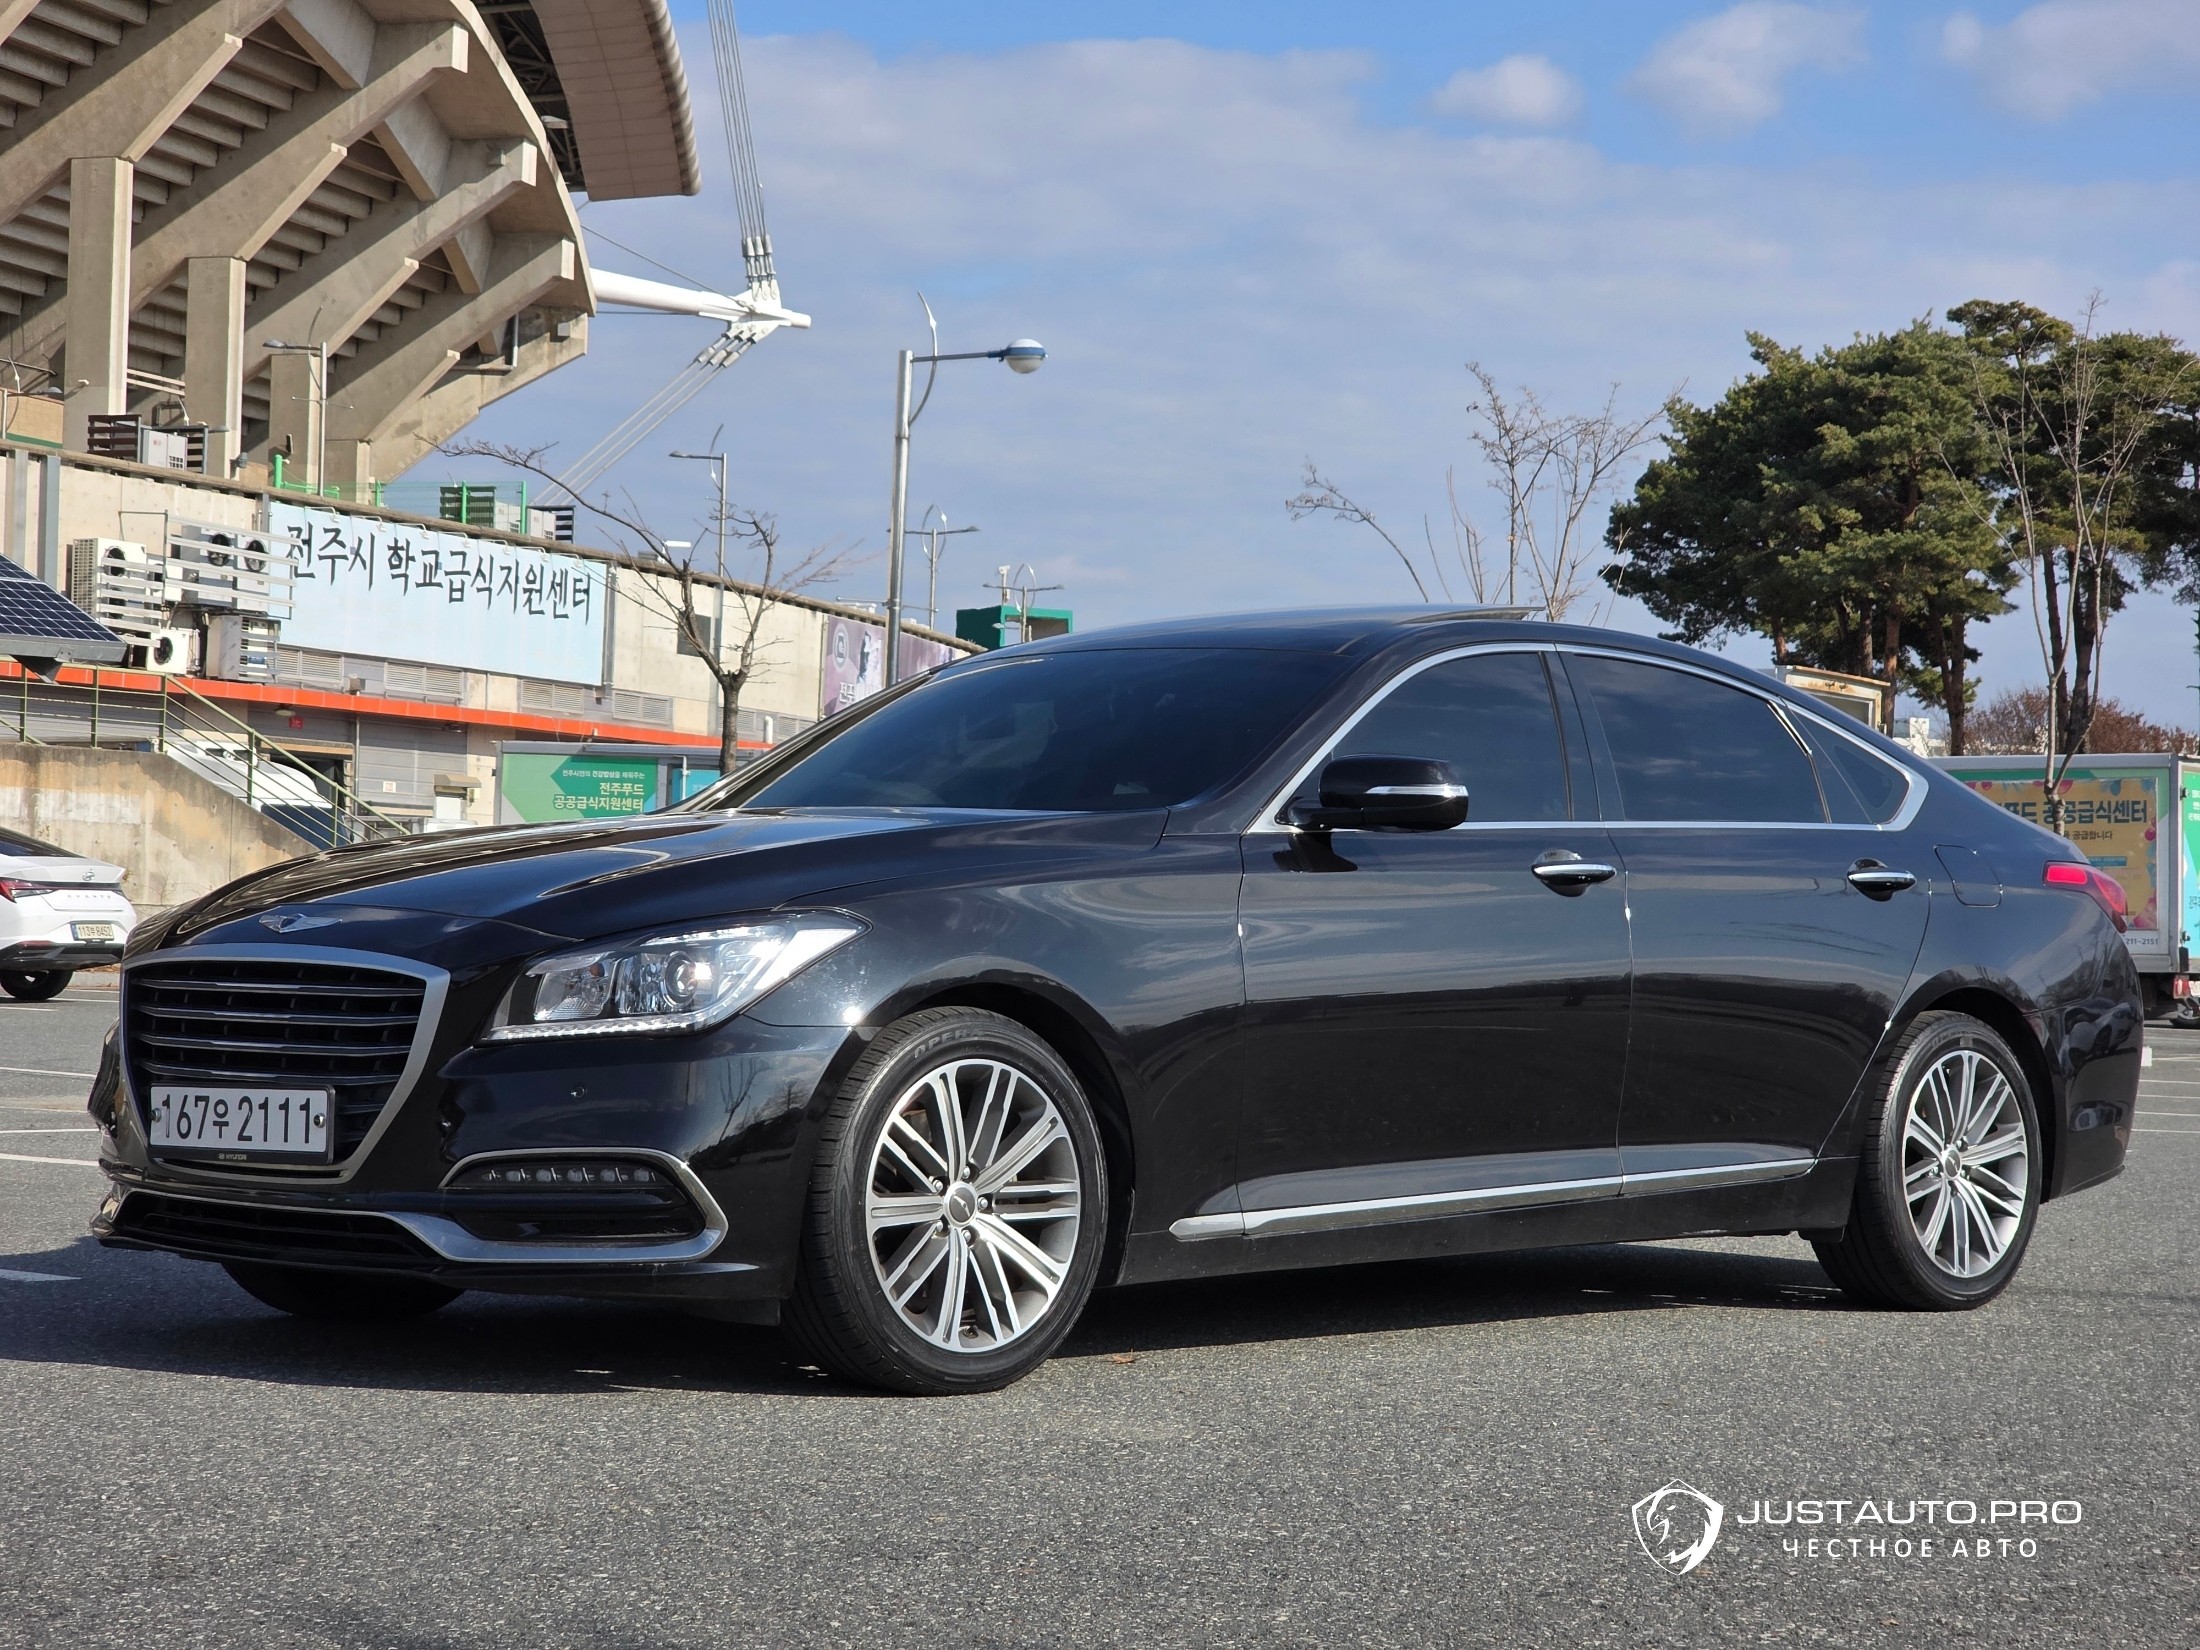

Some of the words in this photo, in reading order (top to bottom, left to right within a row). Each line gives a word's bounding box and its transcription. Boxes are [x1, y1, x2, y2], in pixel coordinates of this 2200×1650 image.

[286, 521, 375, 592] 전주시
[387, 536, 591, 626] 학교급식지원센터
[599, 782, 645, 796] 전주푸드
[554, 795, 643, 813] 공공급식지원센터
